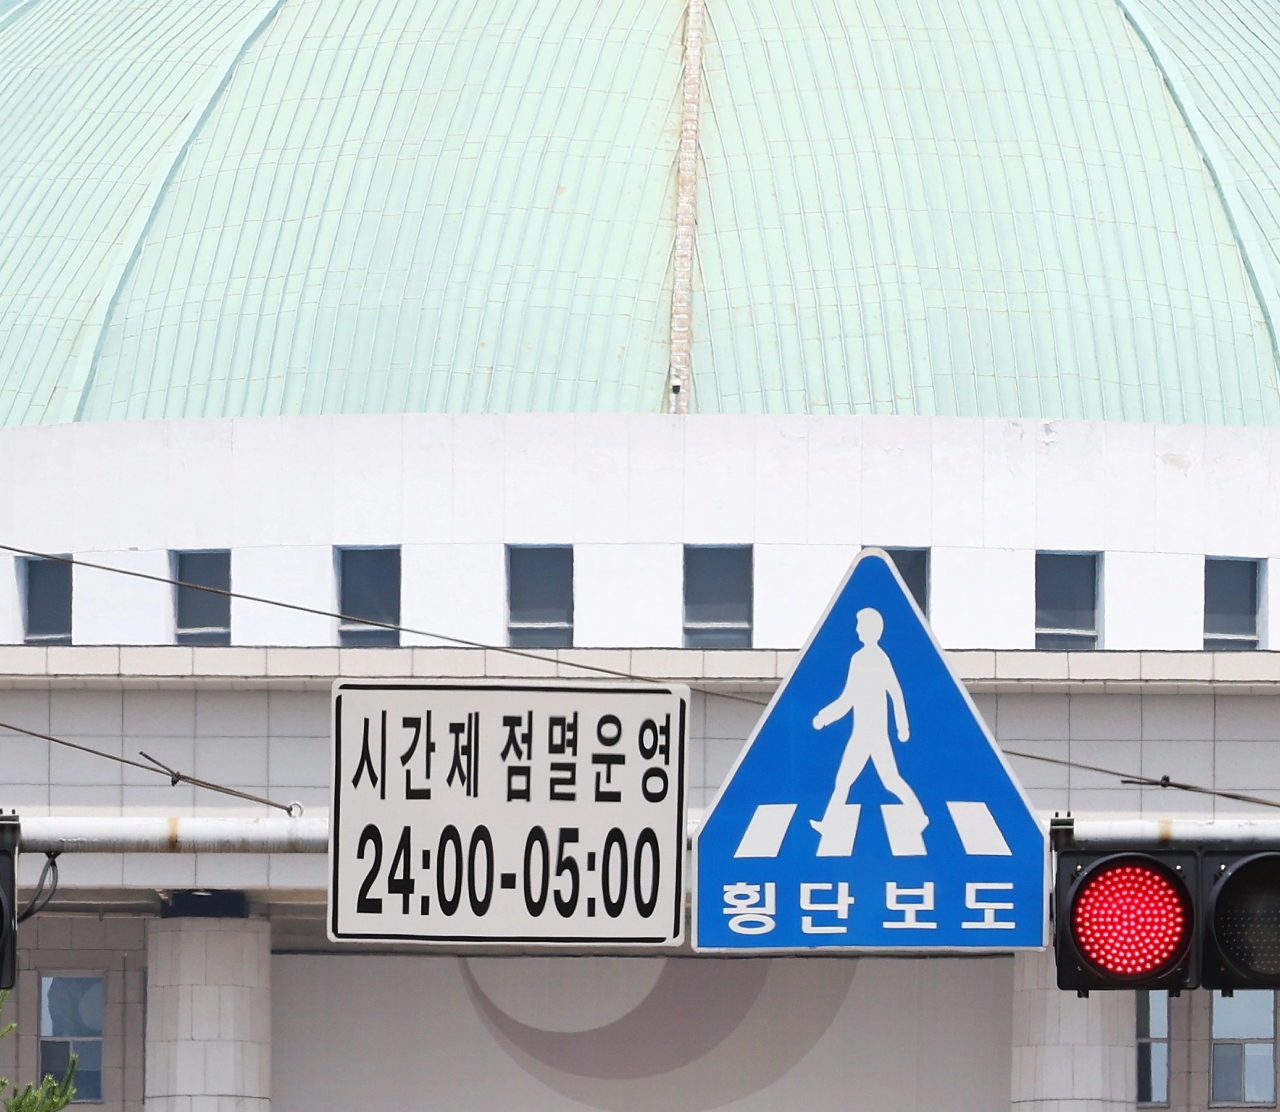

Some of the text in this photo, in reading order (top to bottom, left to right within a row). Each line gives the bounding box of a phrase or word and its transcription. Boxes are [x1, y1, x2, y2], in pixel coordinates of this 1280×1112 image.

[352, 710, 671, 803] 시간제 점멸운영
[356, 823, 661, 919] 24:00-05:00
[723, 882, 1016, 935] 횡단보도
